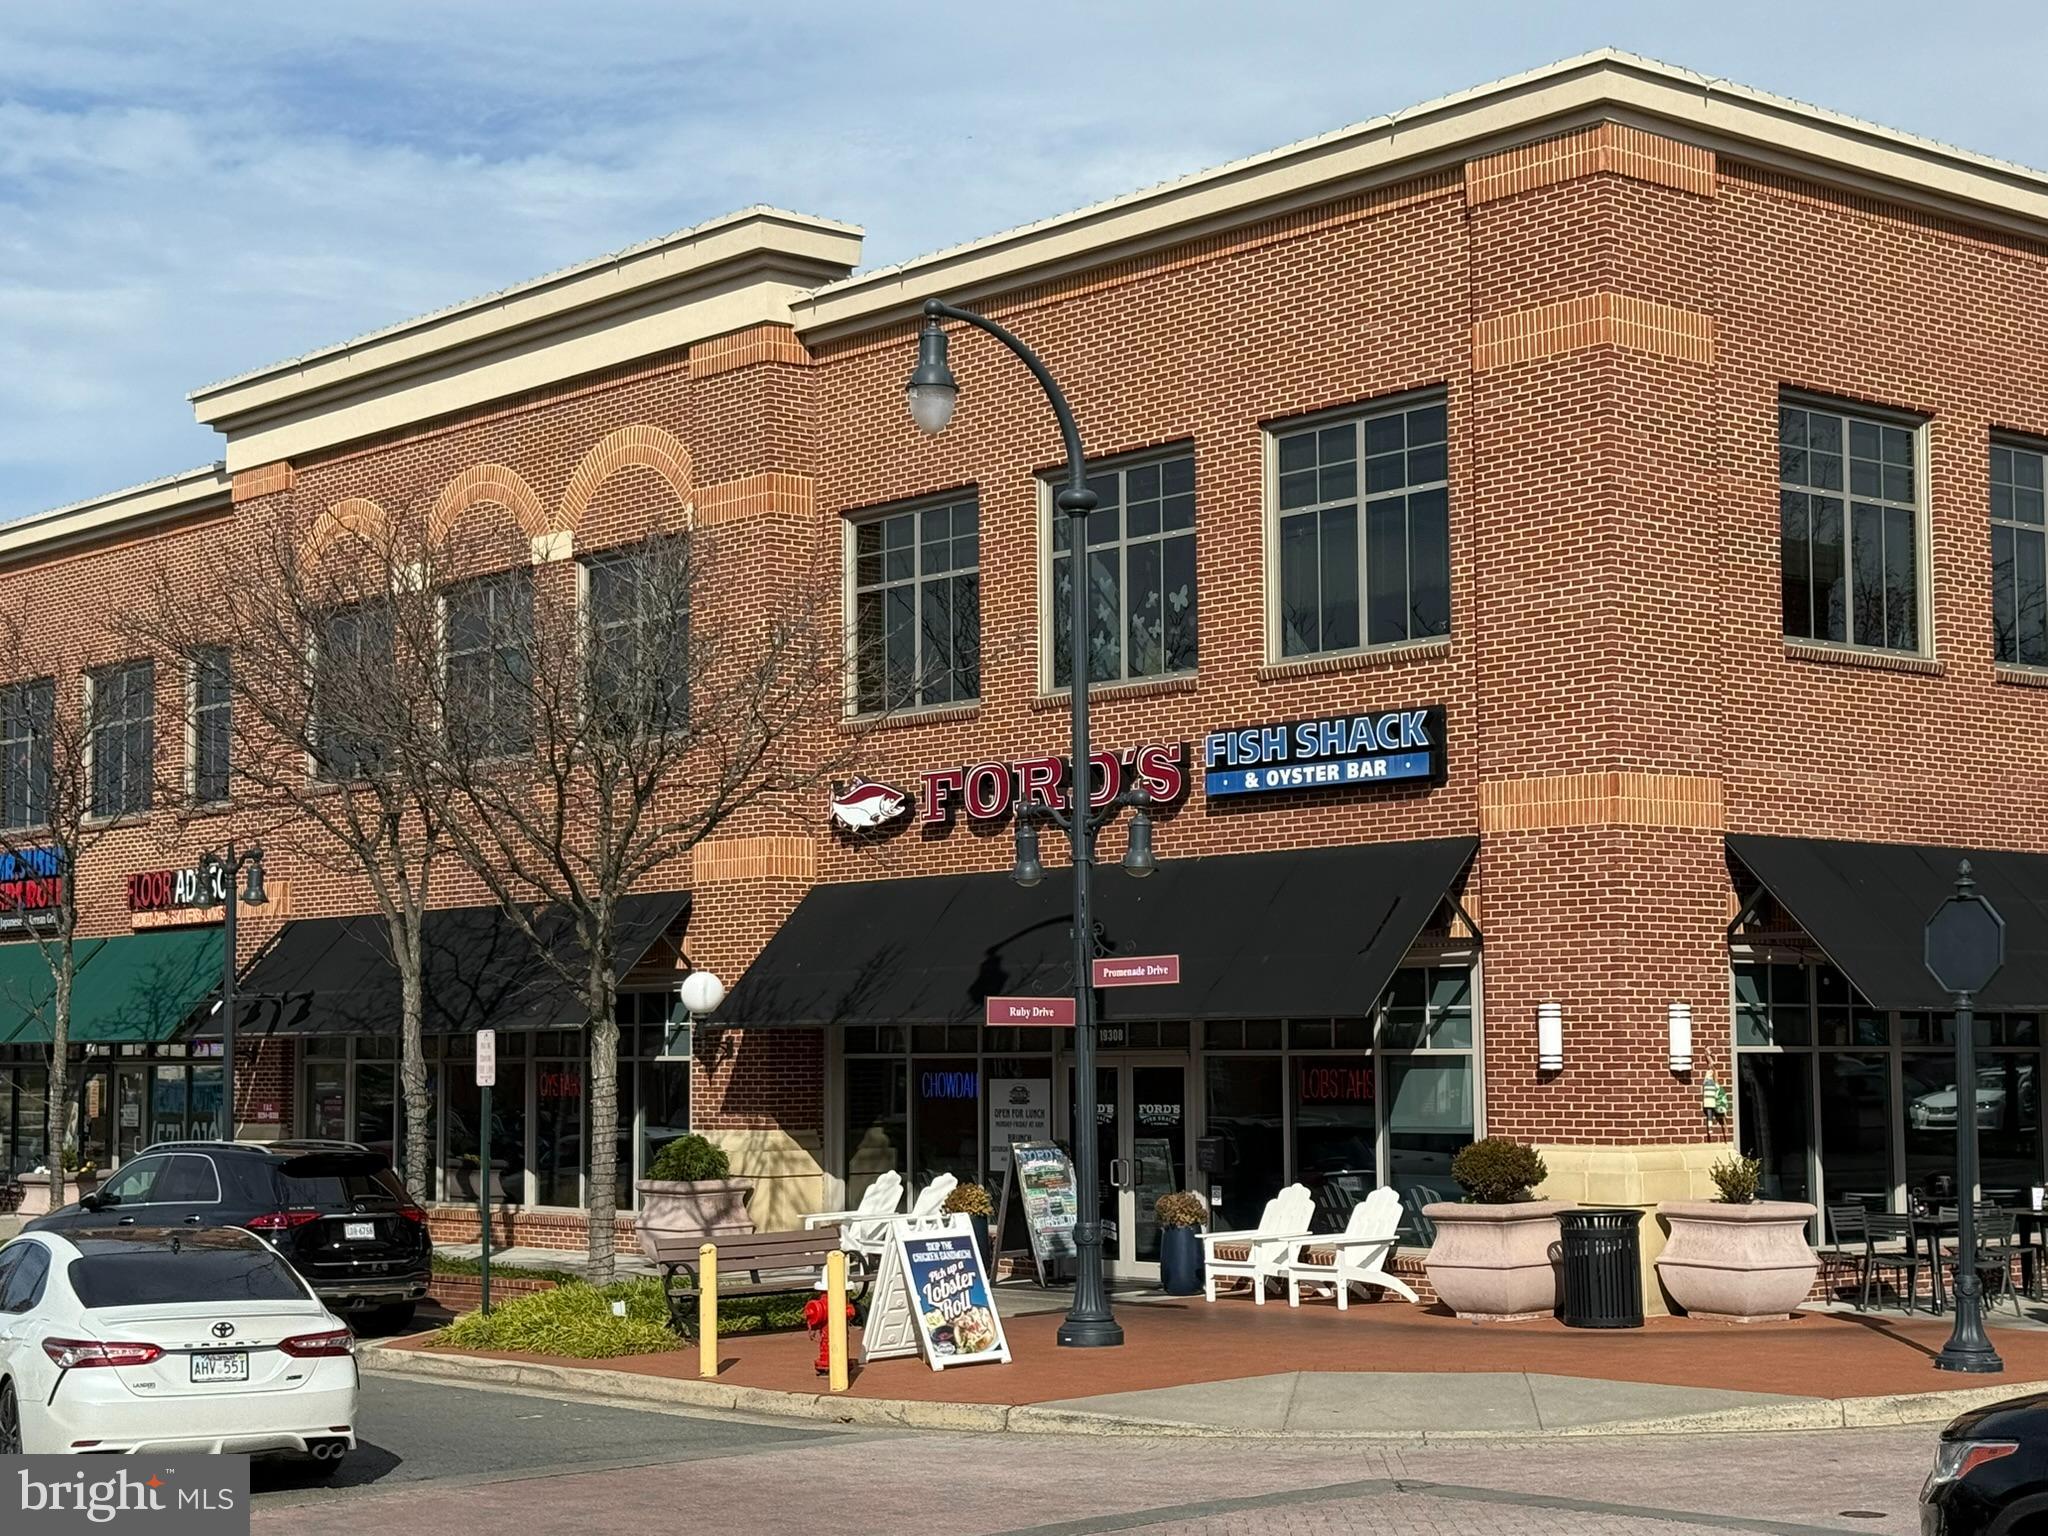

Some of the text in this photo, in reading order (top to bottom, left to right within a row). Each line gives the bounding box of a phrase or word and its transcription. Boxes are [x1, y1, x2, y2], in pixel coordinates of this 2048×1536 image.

[1206, 710, 1430, 768] FISH SHACK
[920, 743, 1182, 822] FORD'S
[1245, 759, 1388, 789] & OYSTER BAR
[127, 871, 172, 909] FLOOR
[1103, 965, 1169, 978] Promenade Drive
[1009, 1006, 1055, 1020] Ruby Drive
[1099, 1028, 1124, 1042] 19308
[921, 1071, 979, 1099] CHOWDAH
[1302, 1068, 1375, 1100] LOBSTAHS
[1012, 1108, 1023, 1119] FOR
[1025, 1108, 1045, 1119] LUNCH
[1138, 1103, 1181, 1114] FORD'S
[912, 1251, 940, 1262] CHICKEN
[928, 1261, 964, 1283] Pick up a
[923, 1271, 976, 1305] Lobster
[940, 1290, 972, 1321] Roll
[194, 1361, 216, 1375] AHV
